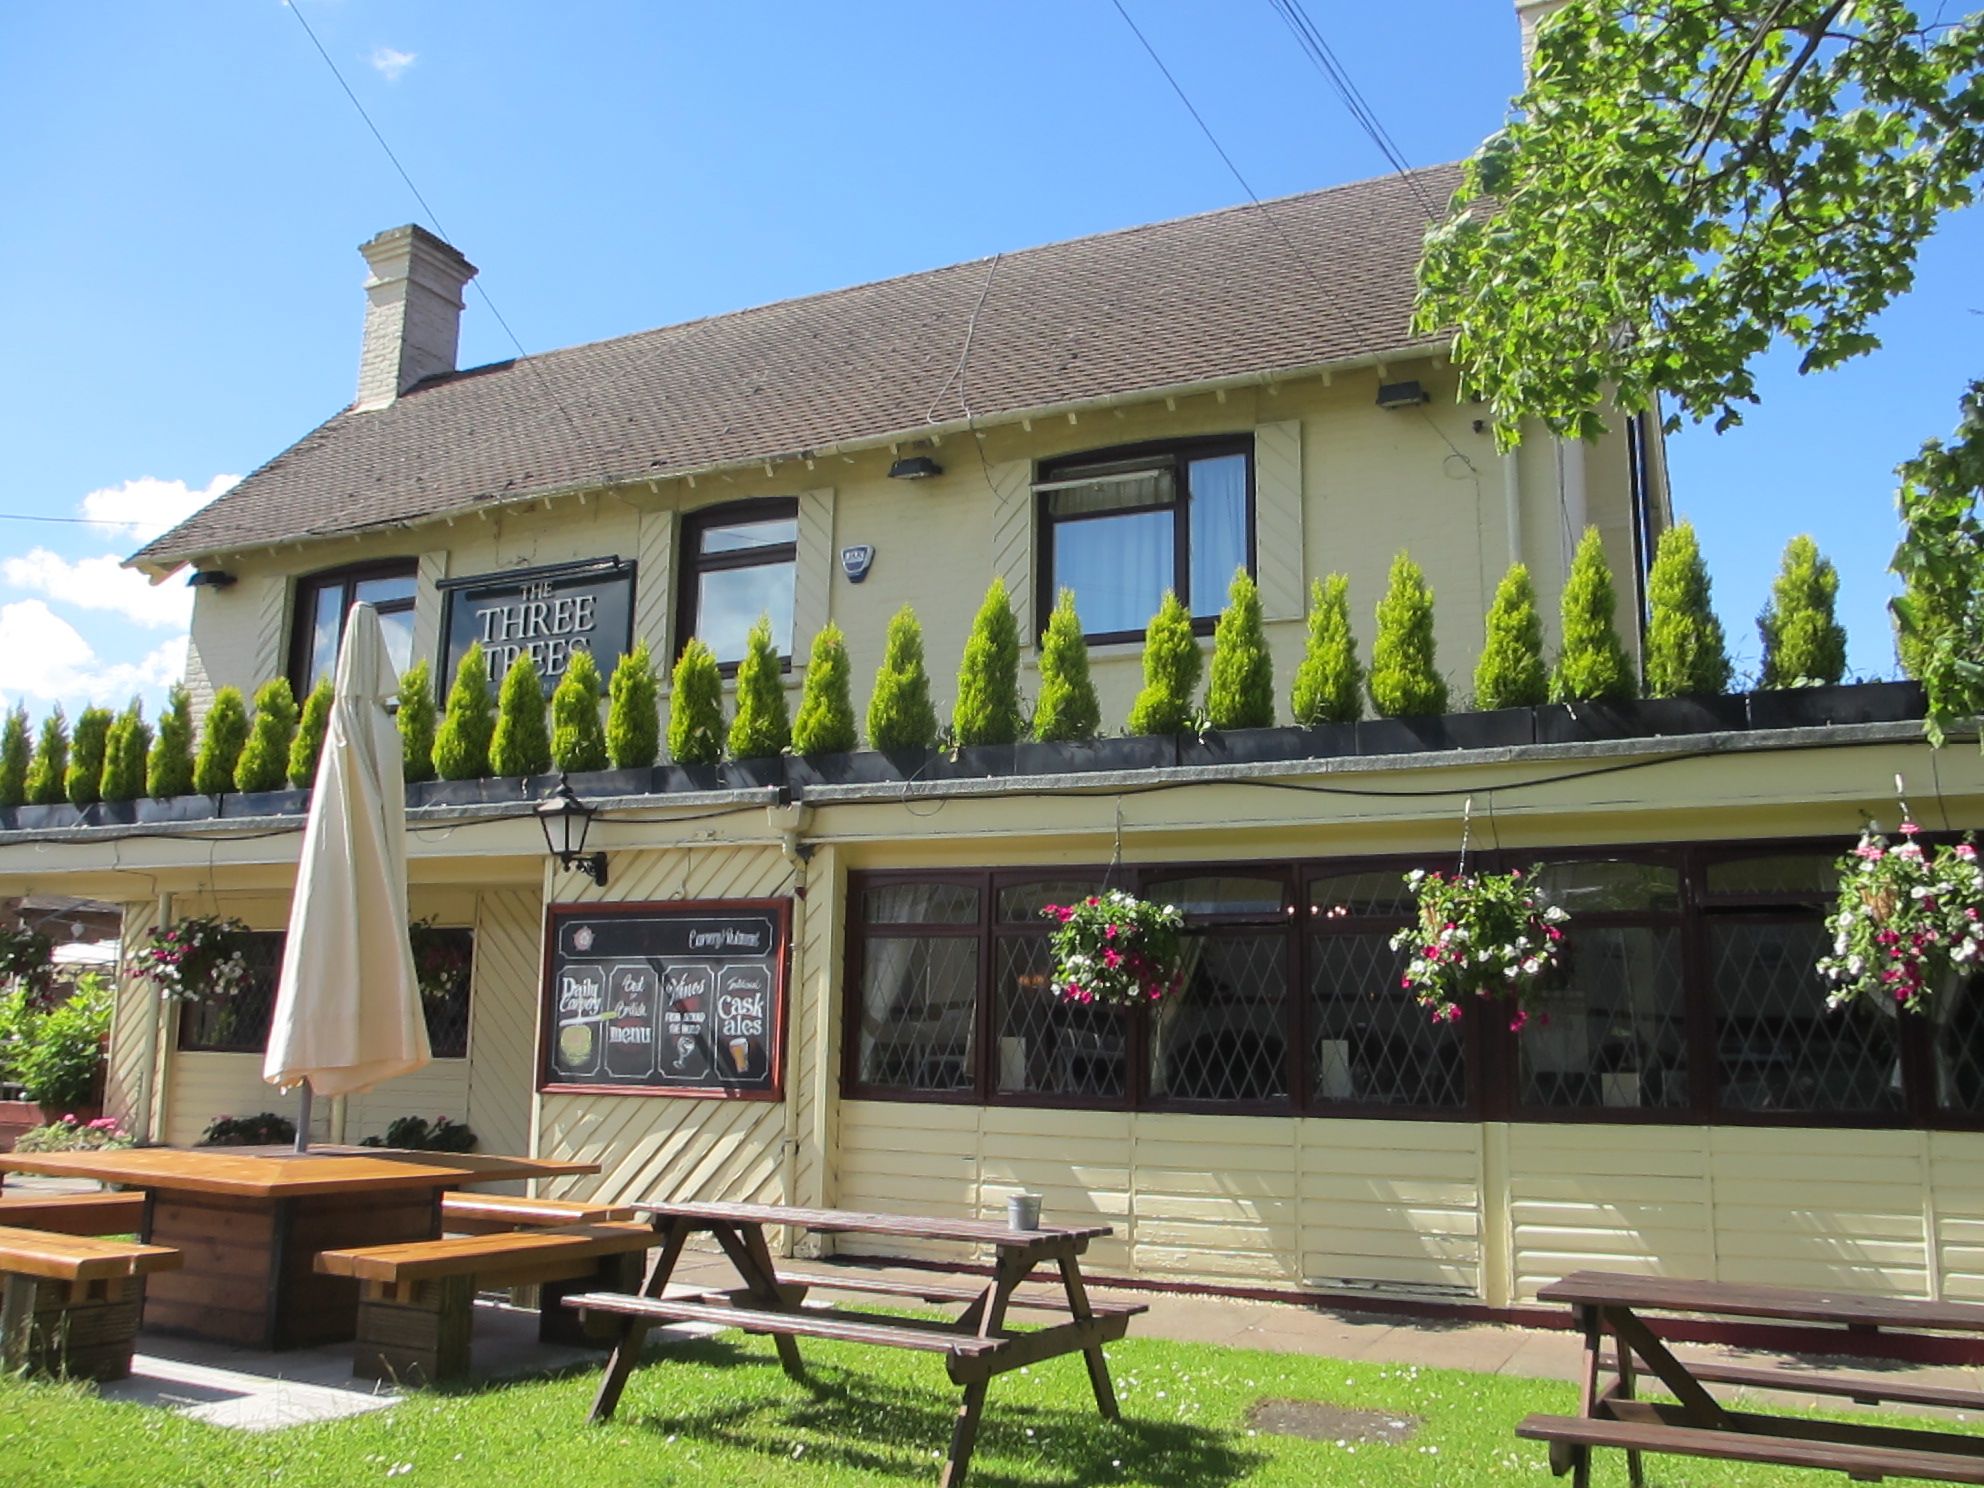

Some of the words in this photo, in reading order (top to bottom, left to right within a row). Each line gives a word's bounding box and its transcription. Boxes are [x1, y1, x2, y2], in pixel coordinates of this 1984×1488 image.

[520, 581, 554, 601] THE
[476, 595, 596, 643] THREE
[562, 977, 600, 998] Daily
[718, 992, 764, 1020] Cask
[609, 1026, 652, 1044] menu
[723, 1014, 763, 1036] ales
